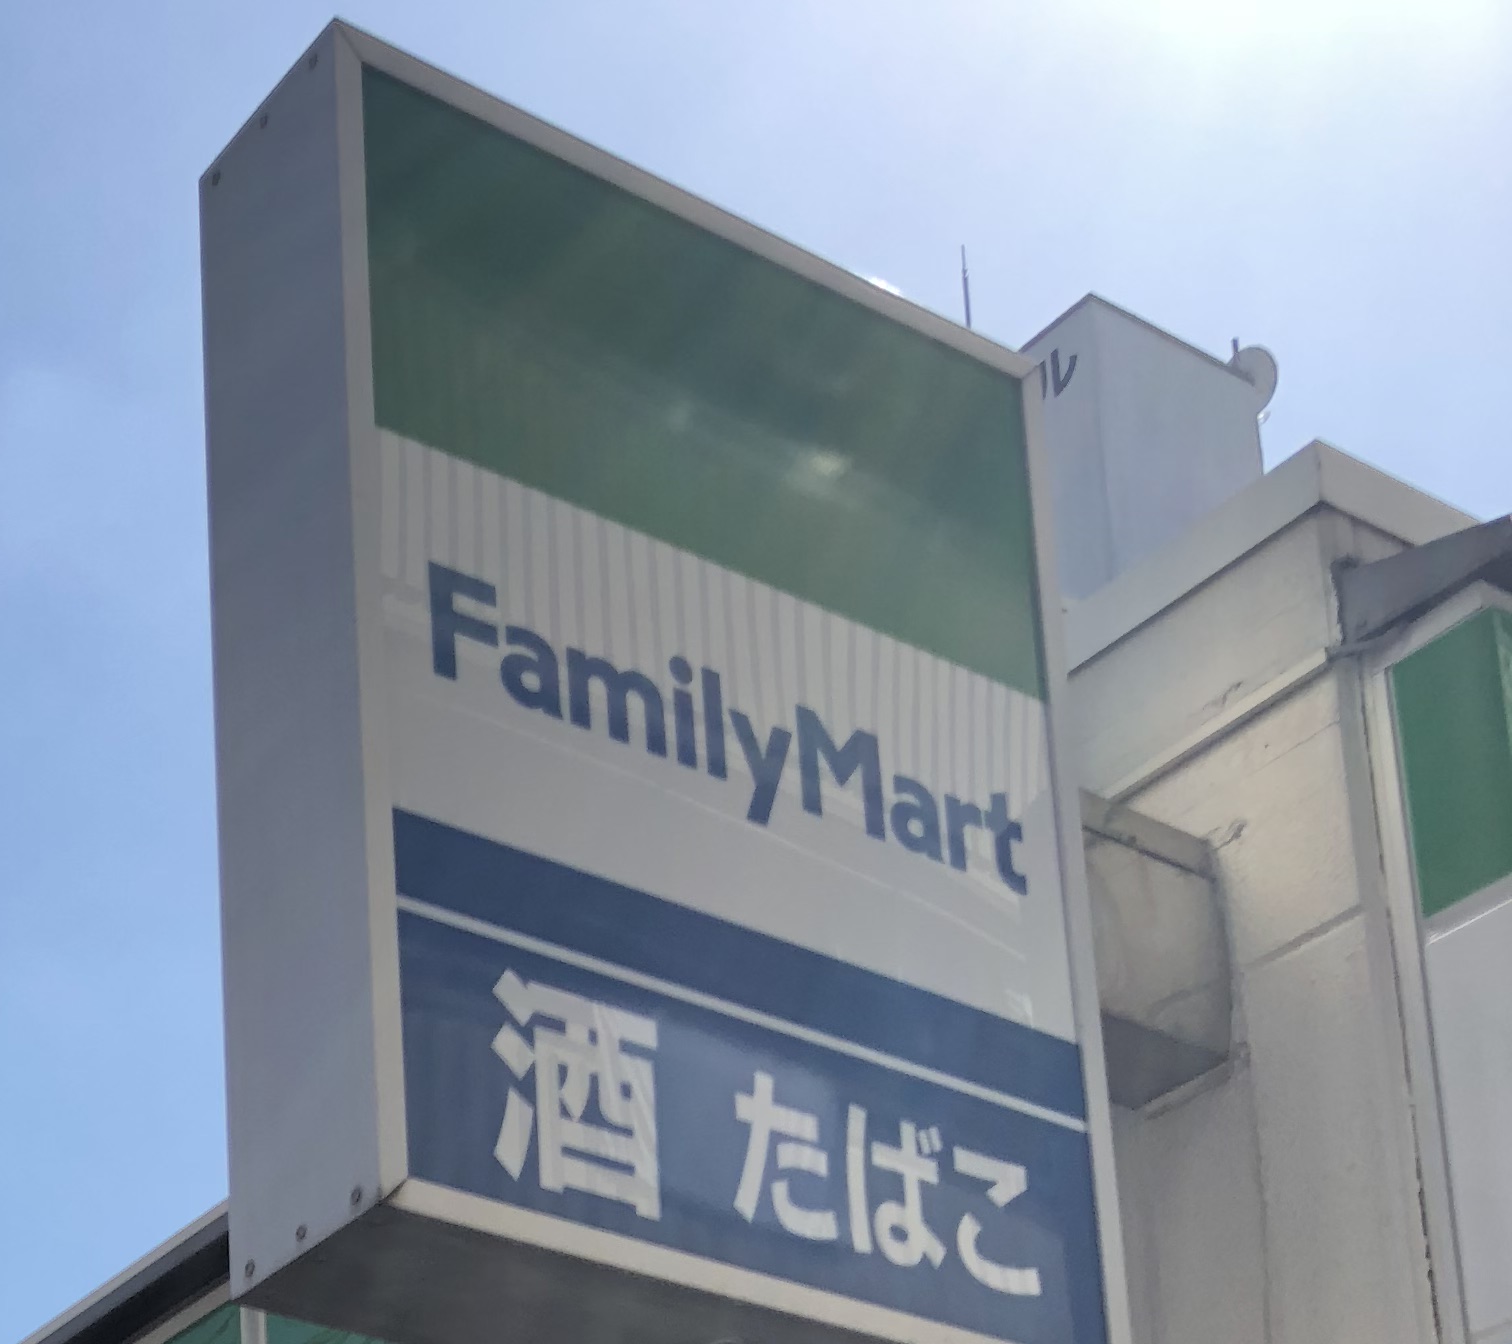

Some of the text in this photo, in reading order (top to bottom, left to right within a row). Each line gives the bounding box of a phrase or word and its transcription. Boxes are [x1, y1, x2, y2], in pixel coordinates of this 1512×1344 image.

[427, 561, 1028, 897] FamilyMart
[492, 967, 1042, 1298] 酒 たばこ
